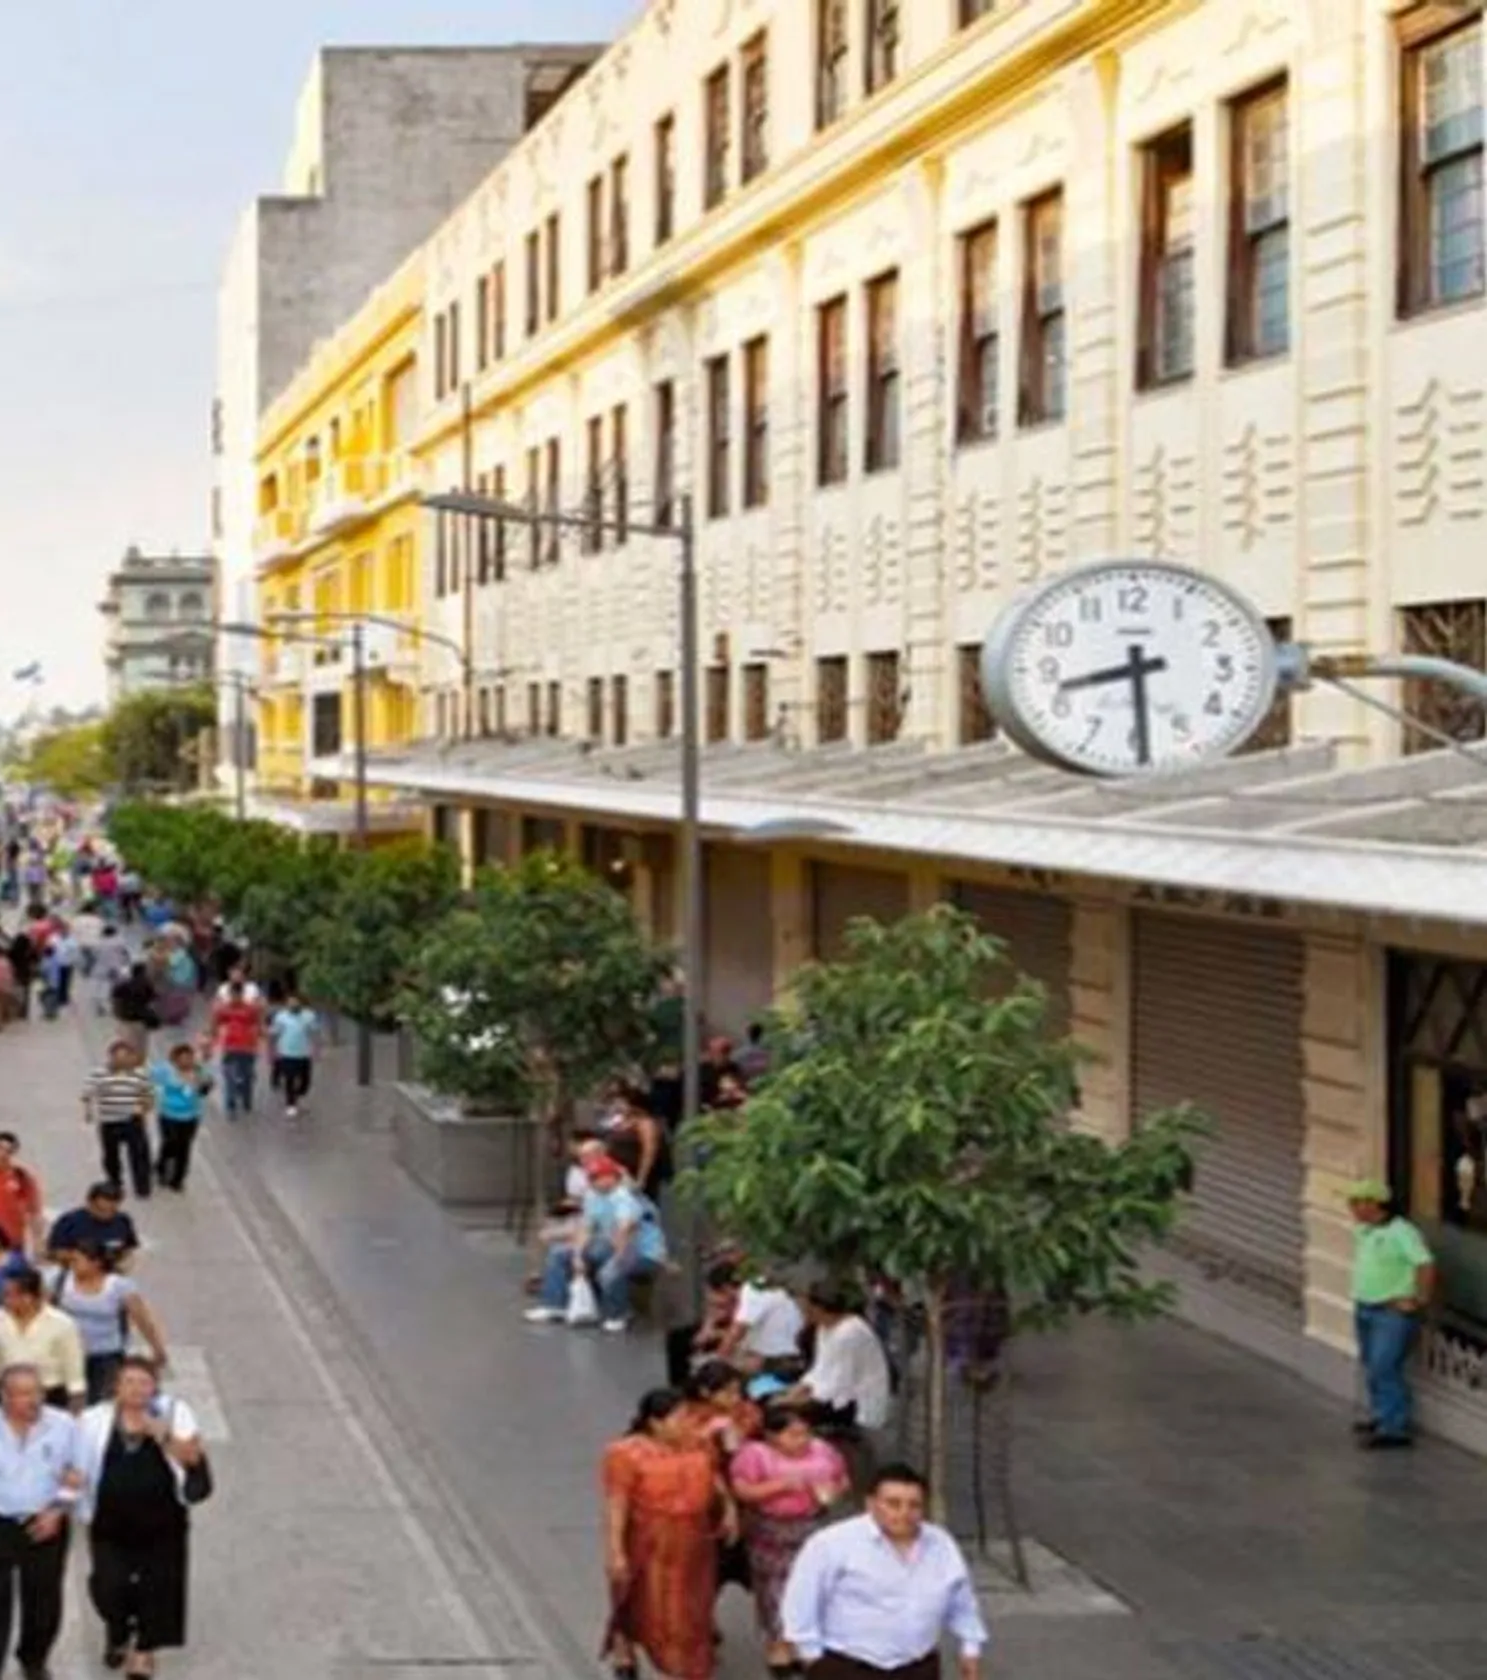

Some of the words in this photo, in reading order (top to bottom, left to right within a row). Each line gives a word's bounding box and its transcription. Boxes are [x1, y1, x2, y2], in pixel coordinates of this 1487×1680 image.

[1118, 586, 1150, 614] 12
[1173, 597, 1184, 621] 1
[1045, 621, 1073, 648] 10
[1202, 619, 1221, 648] 2
[1215, 654, 1234, 683] 3
[1203, 691, 1223, 716] 4
[1085, 715, 1103, 743] 7
